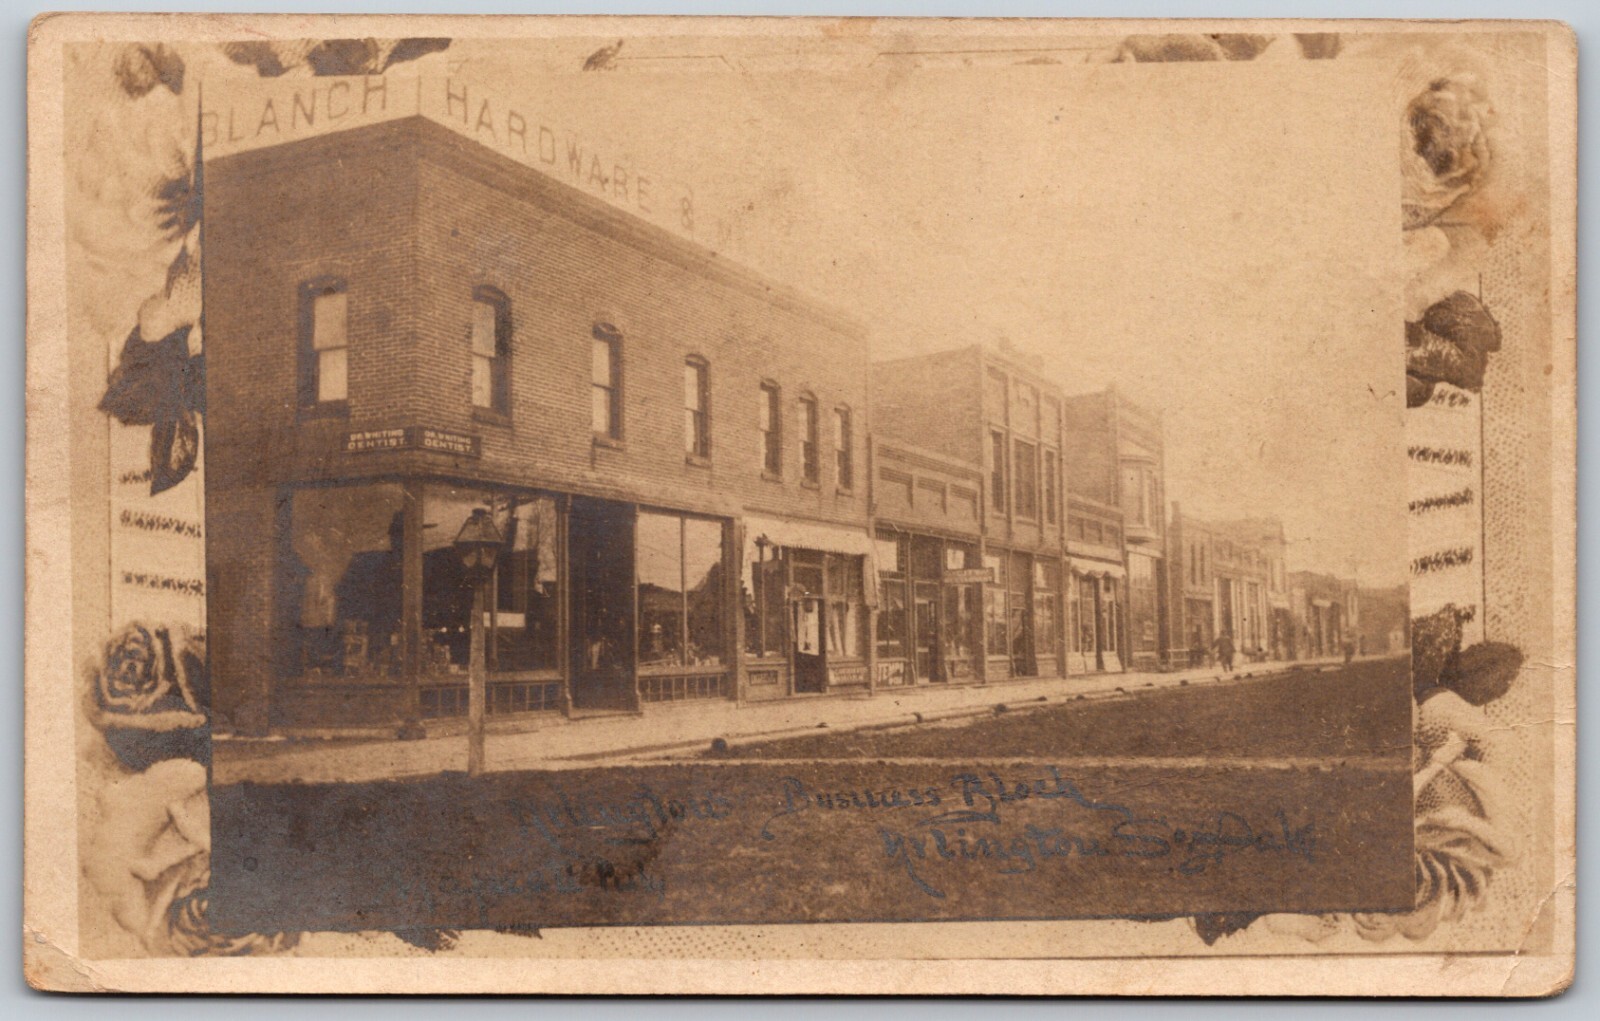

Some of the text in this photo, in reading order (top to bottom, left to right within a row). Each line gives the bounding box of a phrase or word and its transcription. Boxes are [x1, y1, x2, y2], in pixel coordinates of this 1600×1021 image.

[199, 75, 388, 149] BLANCH
[446, 77, 653, 213] HARDWARE
[880, 822, 1108, 898] Arlington
